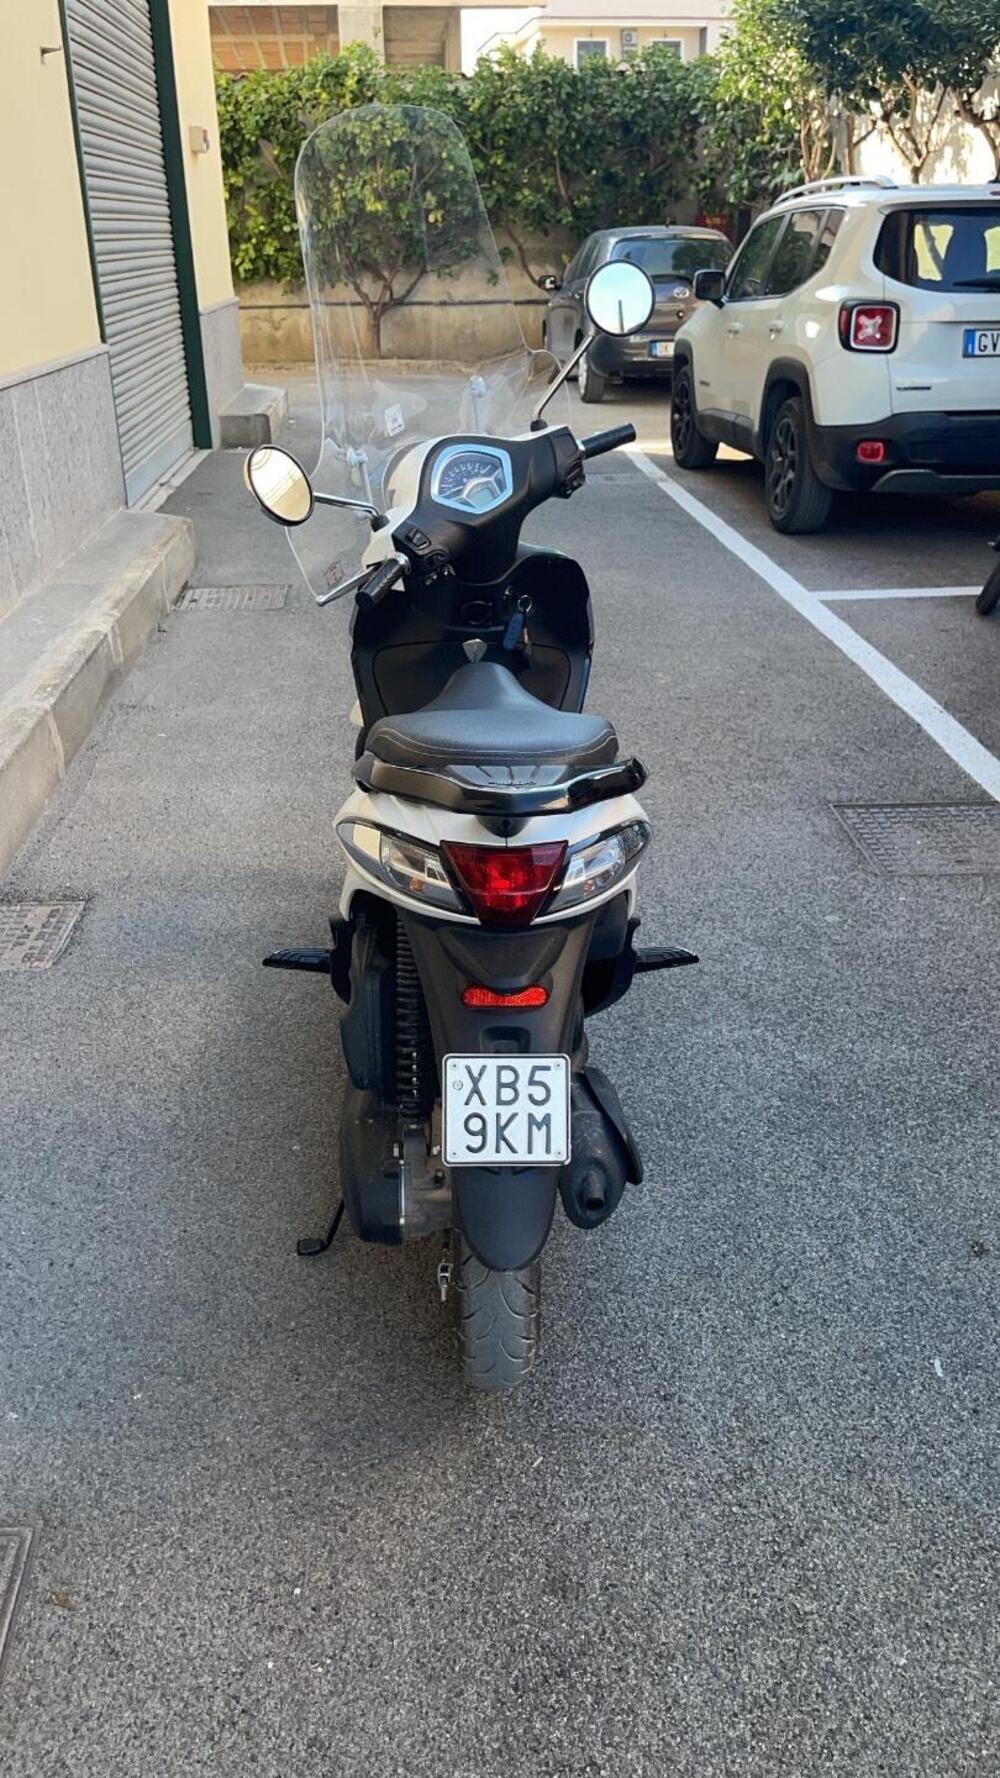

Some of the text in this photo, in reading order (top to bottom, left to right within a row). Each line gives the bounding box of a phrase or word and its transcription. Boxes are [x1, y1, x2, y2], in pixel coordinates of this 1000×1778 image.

[978, 333, 1000, 352] GV
[464, 1064, 552, 1106] XB5
[463, 1112, 552, 1154] 9KM
